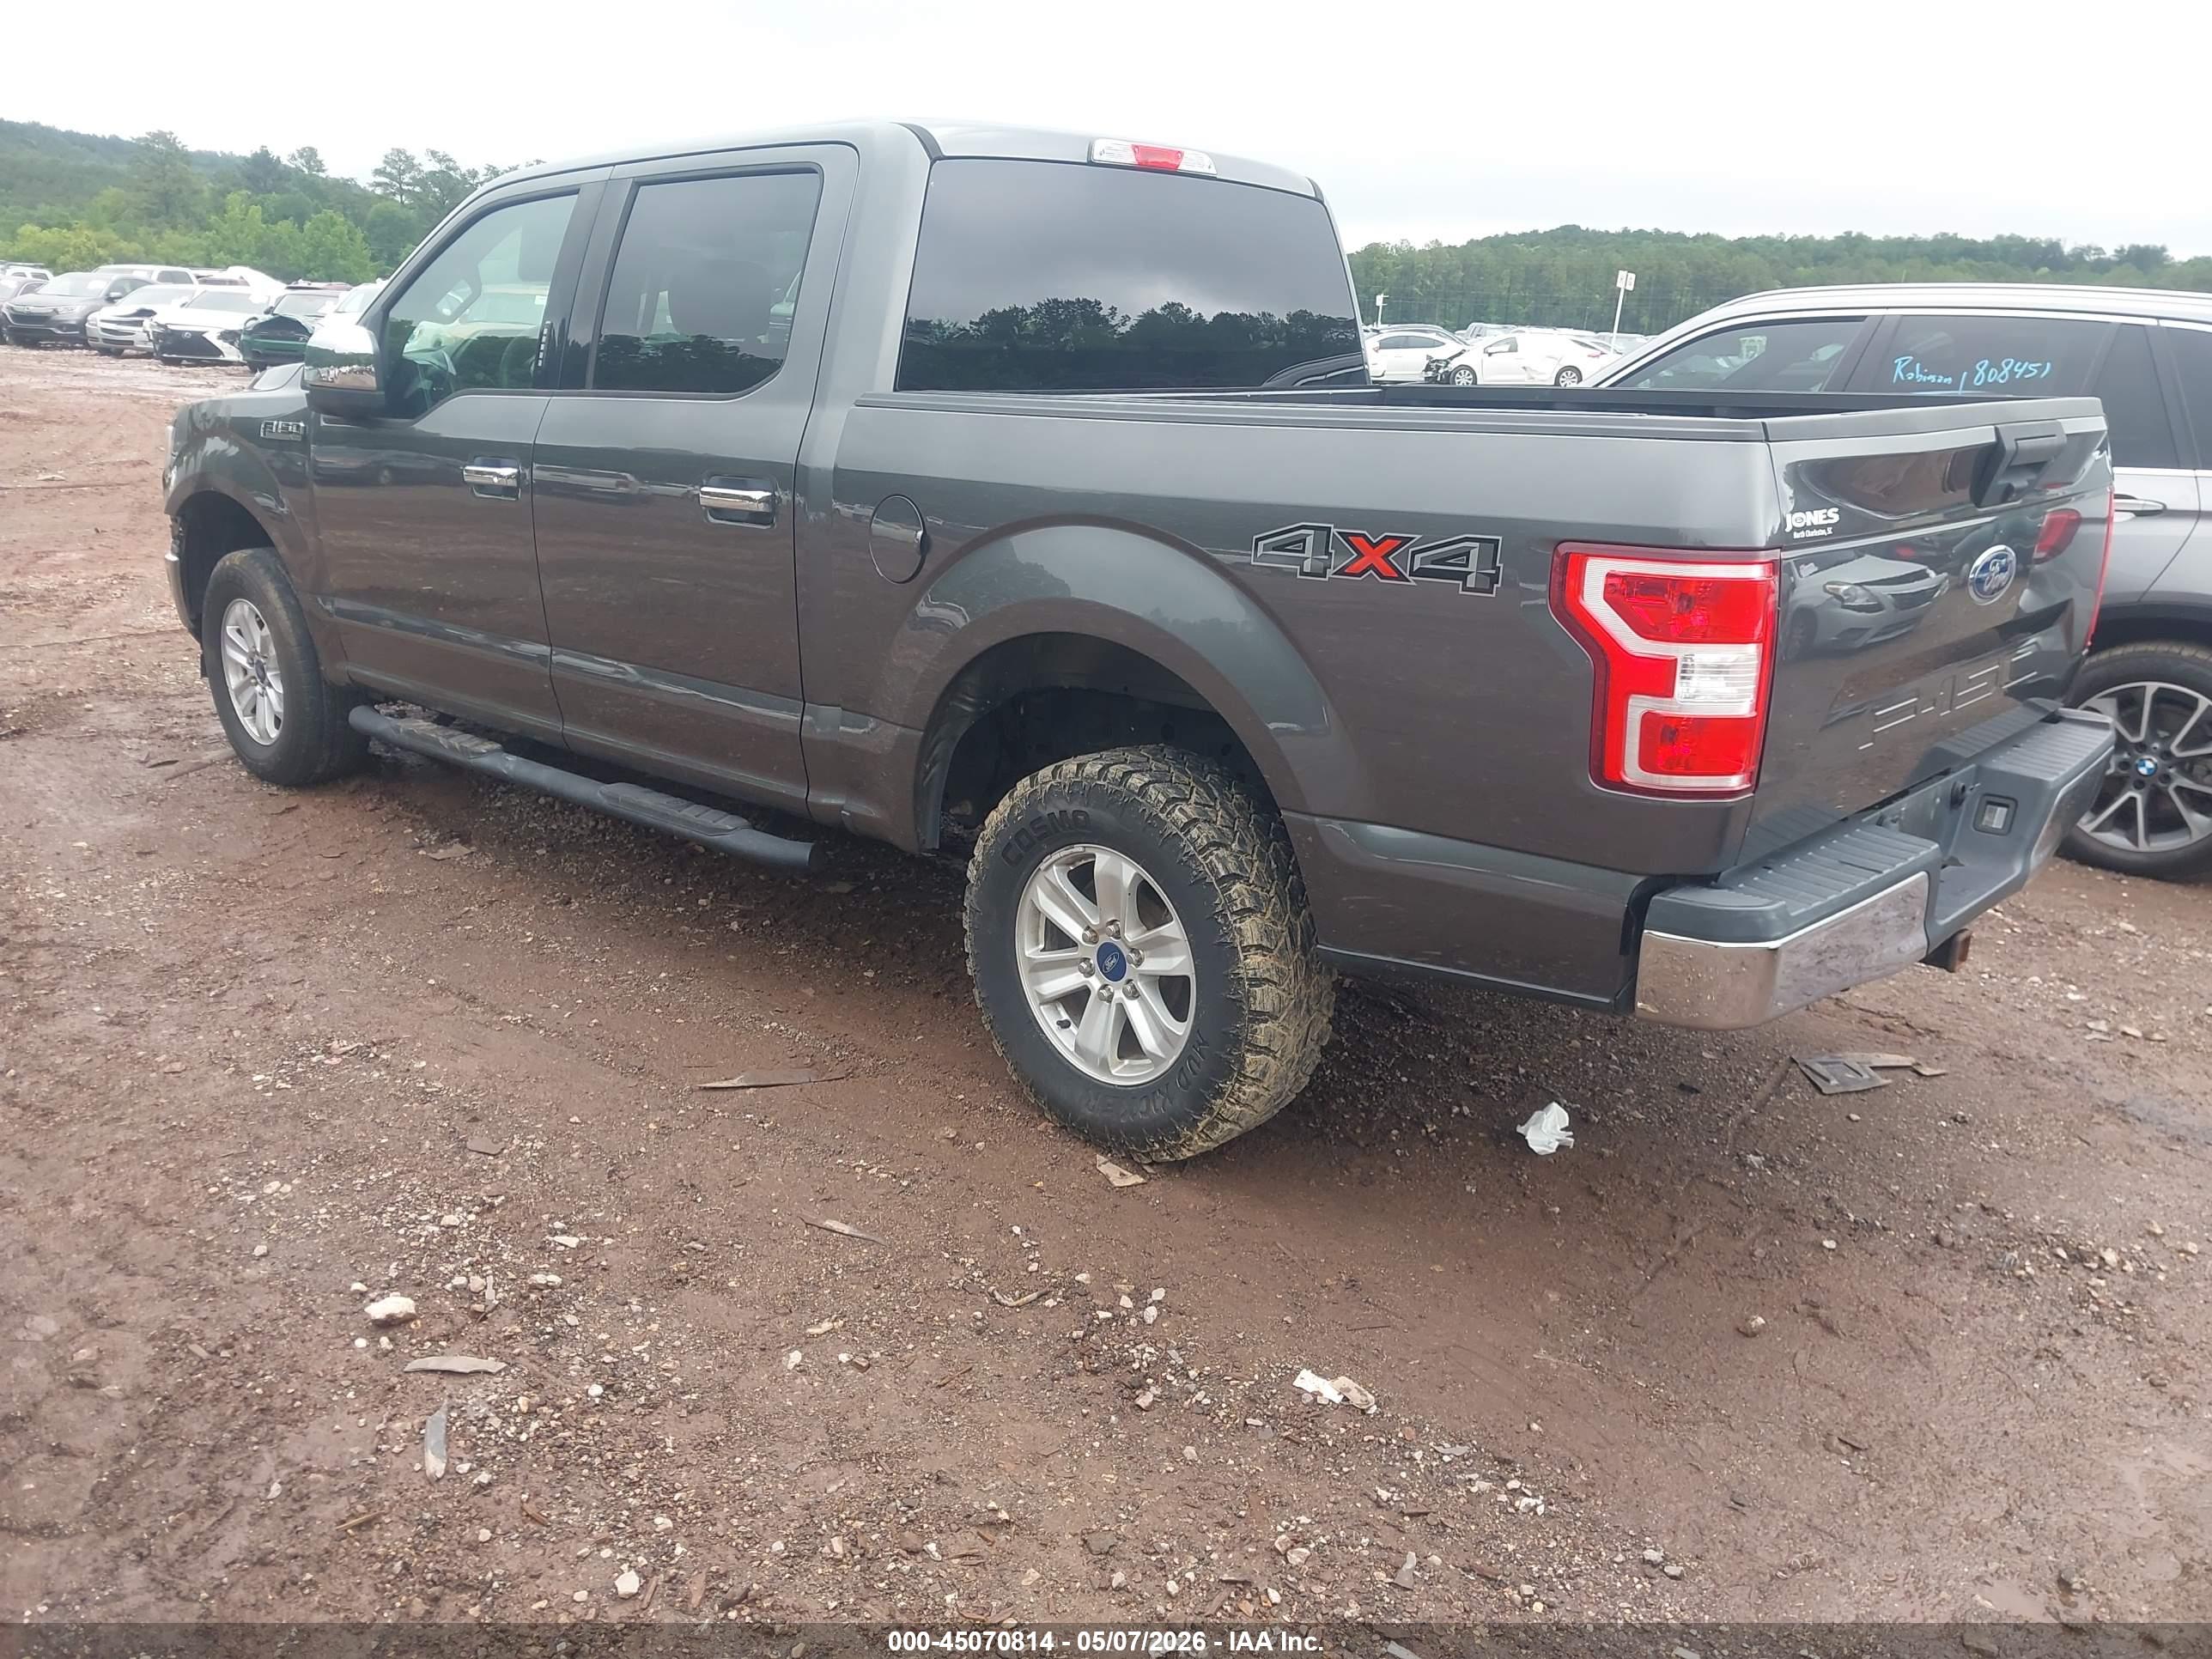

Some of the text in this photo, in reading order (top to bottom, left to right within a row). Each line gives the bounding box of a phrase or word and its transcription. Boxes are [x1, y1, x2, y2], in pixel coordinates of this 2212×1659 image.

[1784, 507, 1840, 532] JONES
[1001, 810, 1091, 867] COSMO
[1175, 1028, 1210, 1093] MUD
